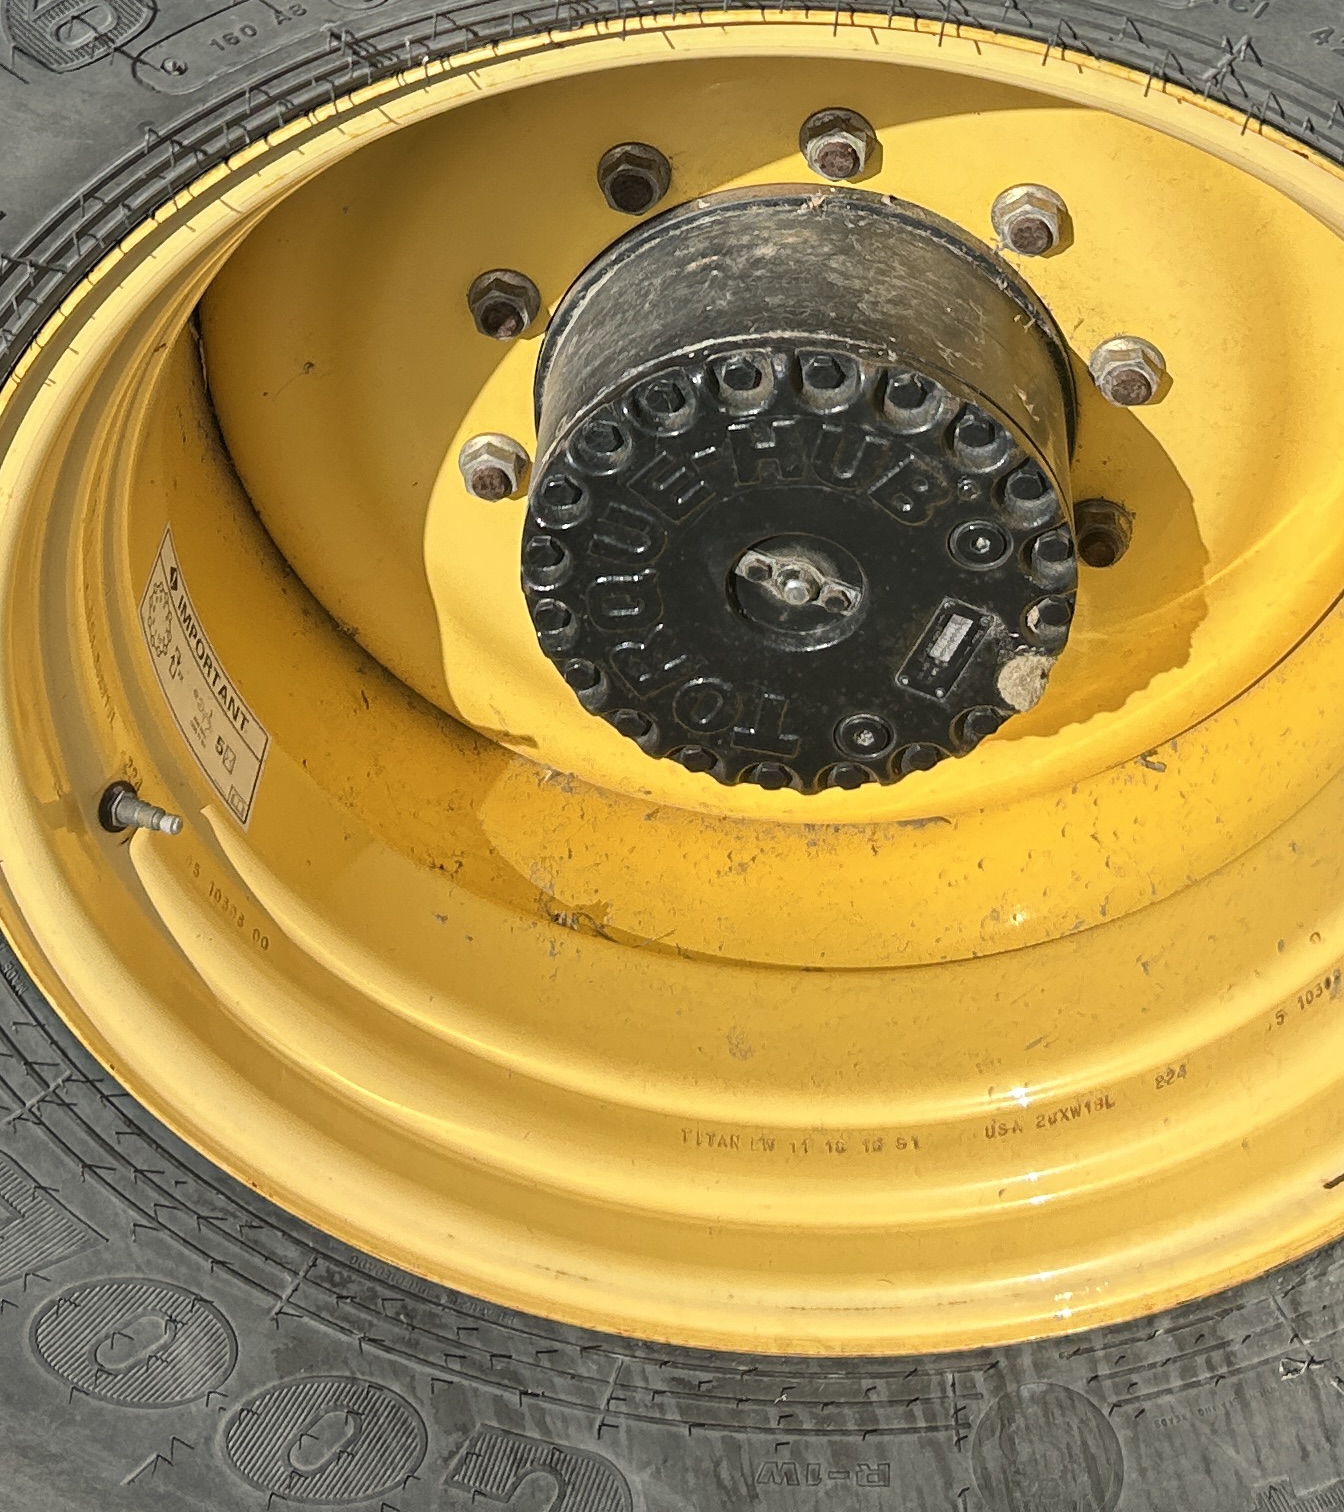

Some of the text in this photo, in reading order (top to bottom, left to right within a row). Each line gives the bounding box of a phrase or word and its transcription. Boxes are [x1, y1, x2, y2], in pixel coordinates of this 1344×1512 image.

[176, 594, 251, 733] IMPORTANT
[214, 735, 225, 756] 5
[1, 960, 31, 998] MADE
[680, 1125, 741, 1152] TITAN
[983, 1118, 1024, 1140] USA
[755, 1460, 891, 1488] R-1W
